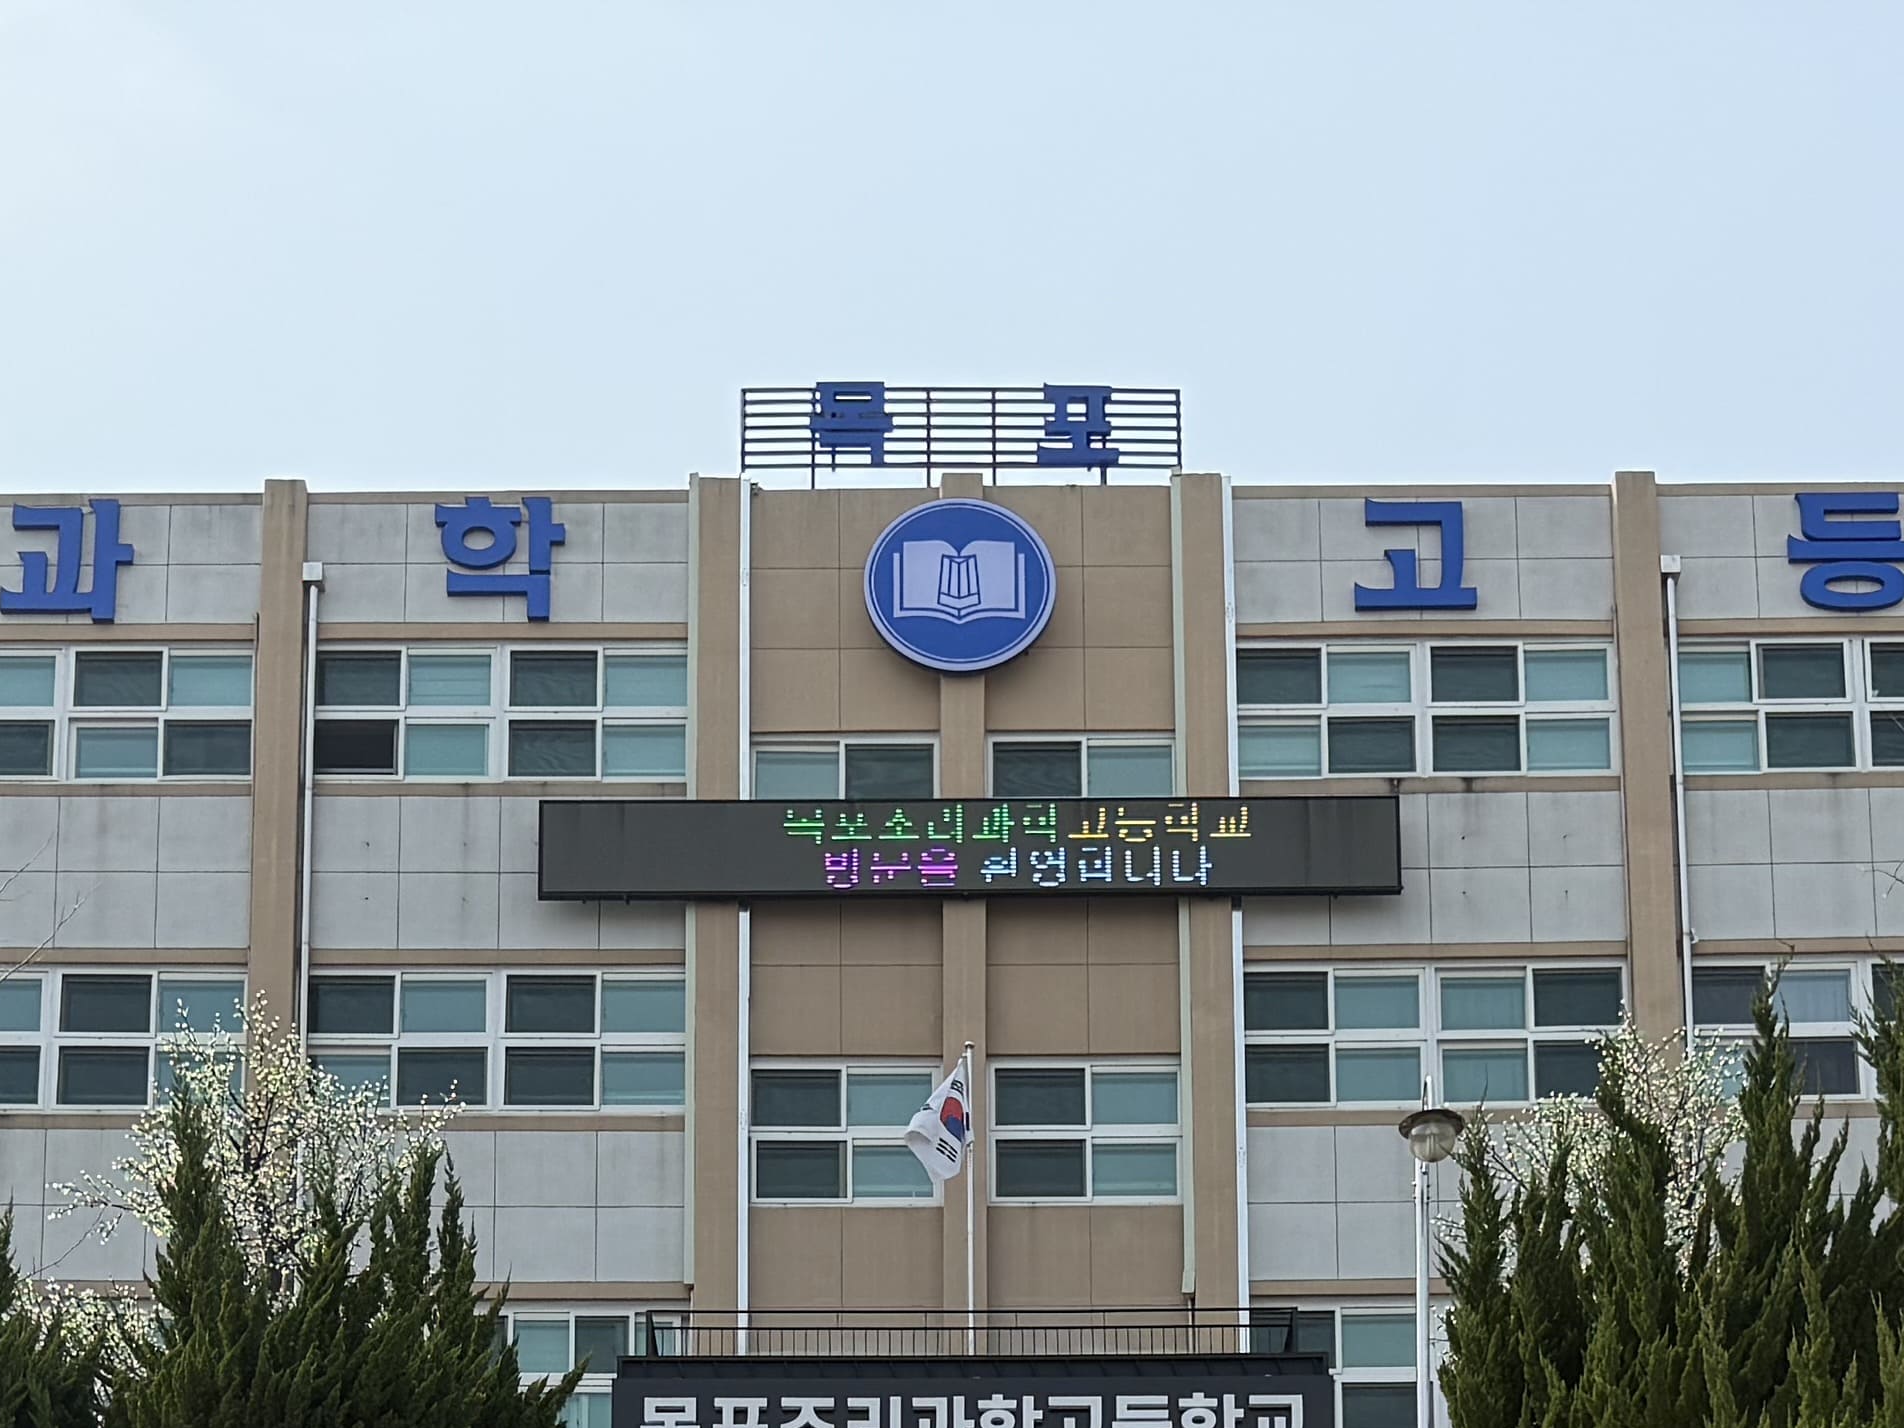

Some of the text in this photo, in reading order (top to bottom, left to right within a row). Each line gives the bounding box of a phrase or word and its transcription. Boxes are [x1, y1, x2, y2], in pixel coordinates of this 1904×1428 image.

[0, 497, 135, 624] 과
[434, 495, 566, 622] 학
[1353, 497, 1478, 612] 고
